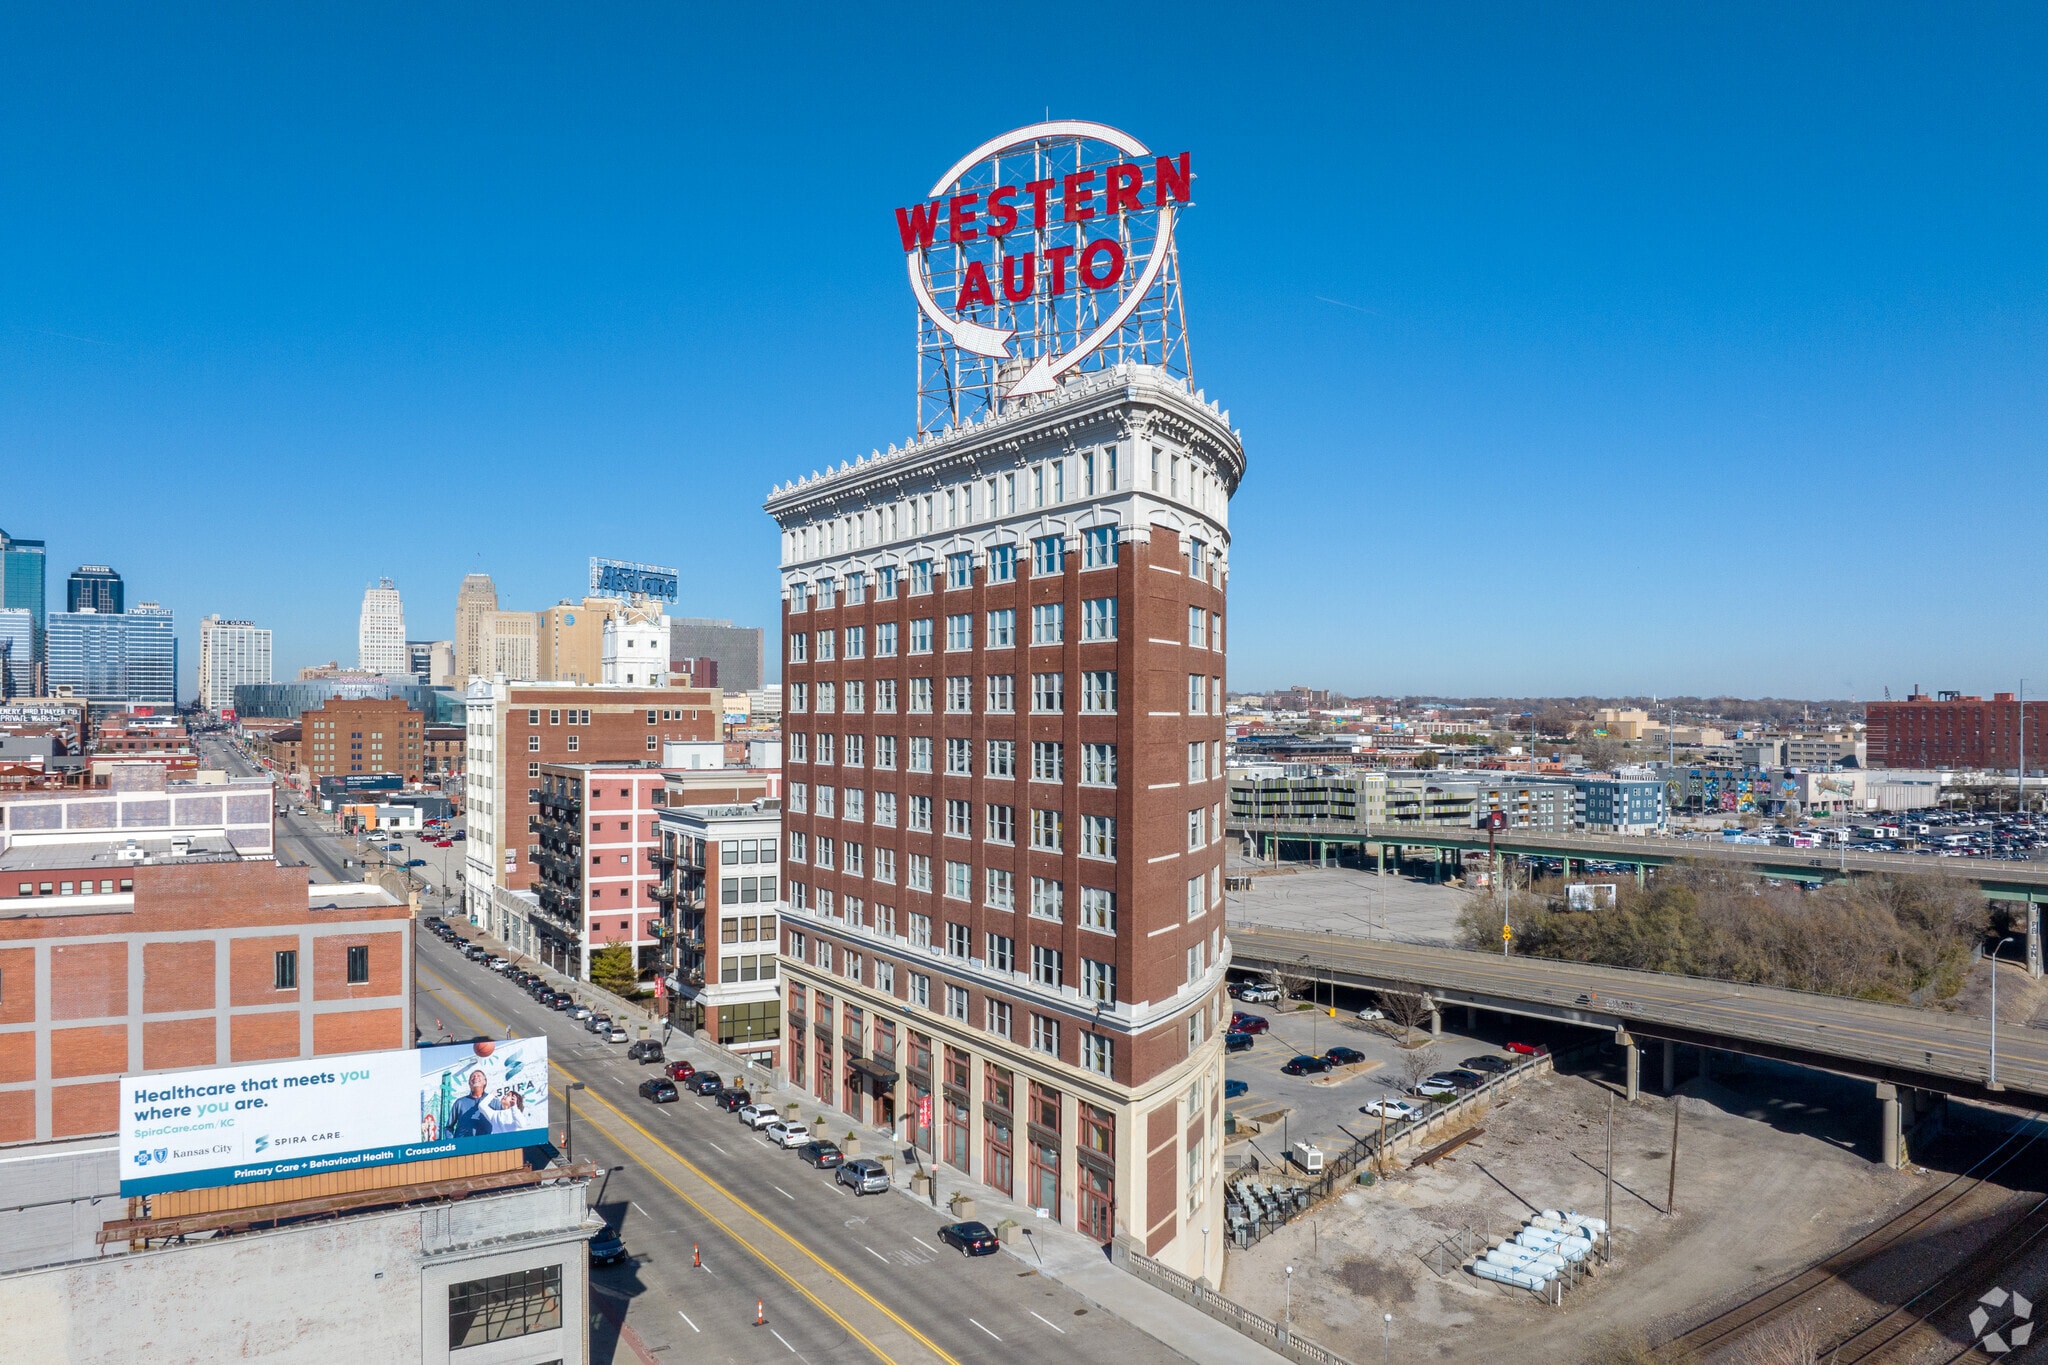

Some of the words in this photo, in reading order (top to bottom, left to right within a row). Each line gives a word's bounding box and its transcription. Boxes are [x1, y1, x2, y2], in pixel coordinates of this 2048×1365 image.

[895, 152, 1190, 252] WESTERN
[956, 239, 1125, 310] AUTO
[134, 1083, 236, 1104] Healthcare
[241, 1077, 278, 1092] that
[283, 1072, 335, 1088] meets
[340, 1070, 370, 1085] you
[134, 1105, 192, 1122] where
[196, 1101, 229, 1118] you
[234, 1098, 268, 1111] are.
[134, 1118, 235, 1139] SpiraCare.com/KC
[274, 1136, 307, 1146] SPIRA
[311, 1131, 341, 1141] CARE
[173, 1146, 210, 1159] Kansas
[212, 1144, 233, 1157] City
[234, 1167, 273, 1179] Primary
[275, 1163, 300, 1173] Care
[309, 1154, 361, 1169] Behavioral
[363, 1150, 394, 1162] Health
[405, 1143, 457, 1156] Crossroads
